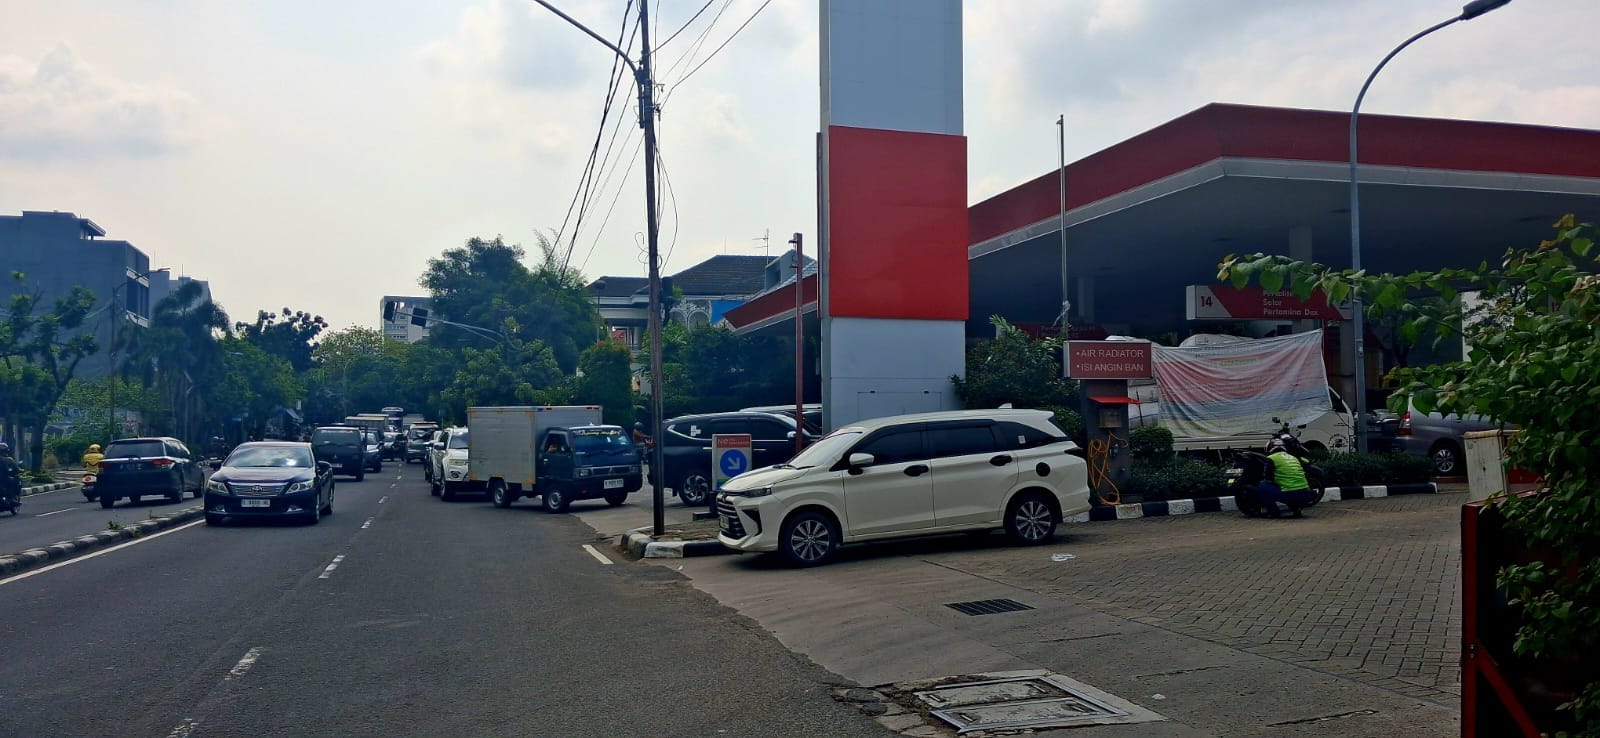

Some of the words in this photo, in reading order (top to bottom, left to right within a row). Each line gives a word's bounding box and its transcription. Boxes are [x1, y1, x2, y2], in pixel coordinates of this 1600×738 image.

[1200, 295, 1212, 307] 14
[1263, 298, 1282, 306] Solar
[1263, 307, 1302, 316] Pertamina
[1081, 349, 1097, 358] AIR
[1098, 349, 1144, 358] RADIATOR
[1081, 363, 1093, 372] ISI
[1094, 363, 1123, 372] ANGIN
[1125, 363, 1144, 372] BAN
